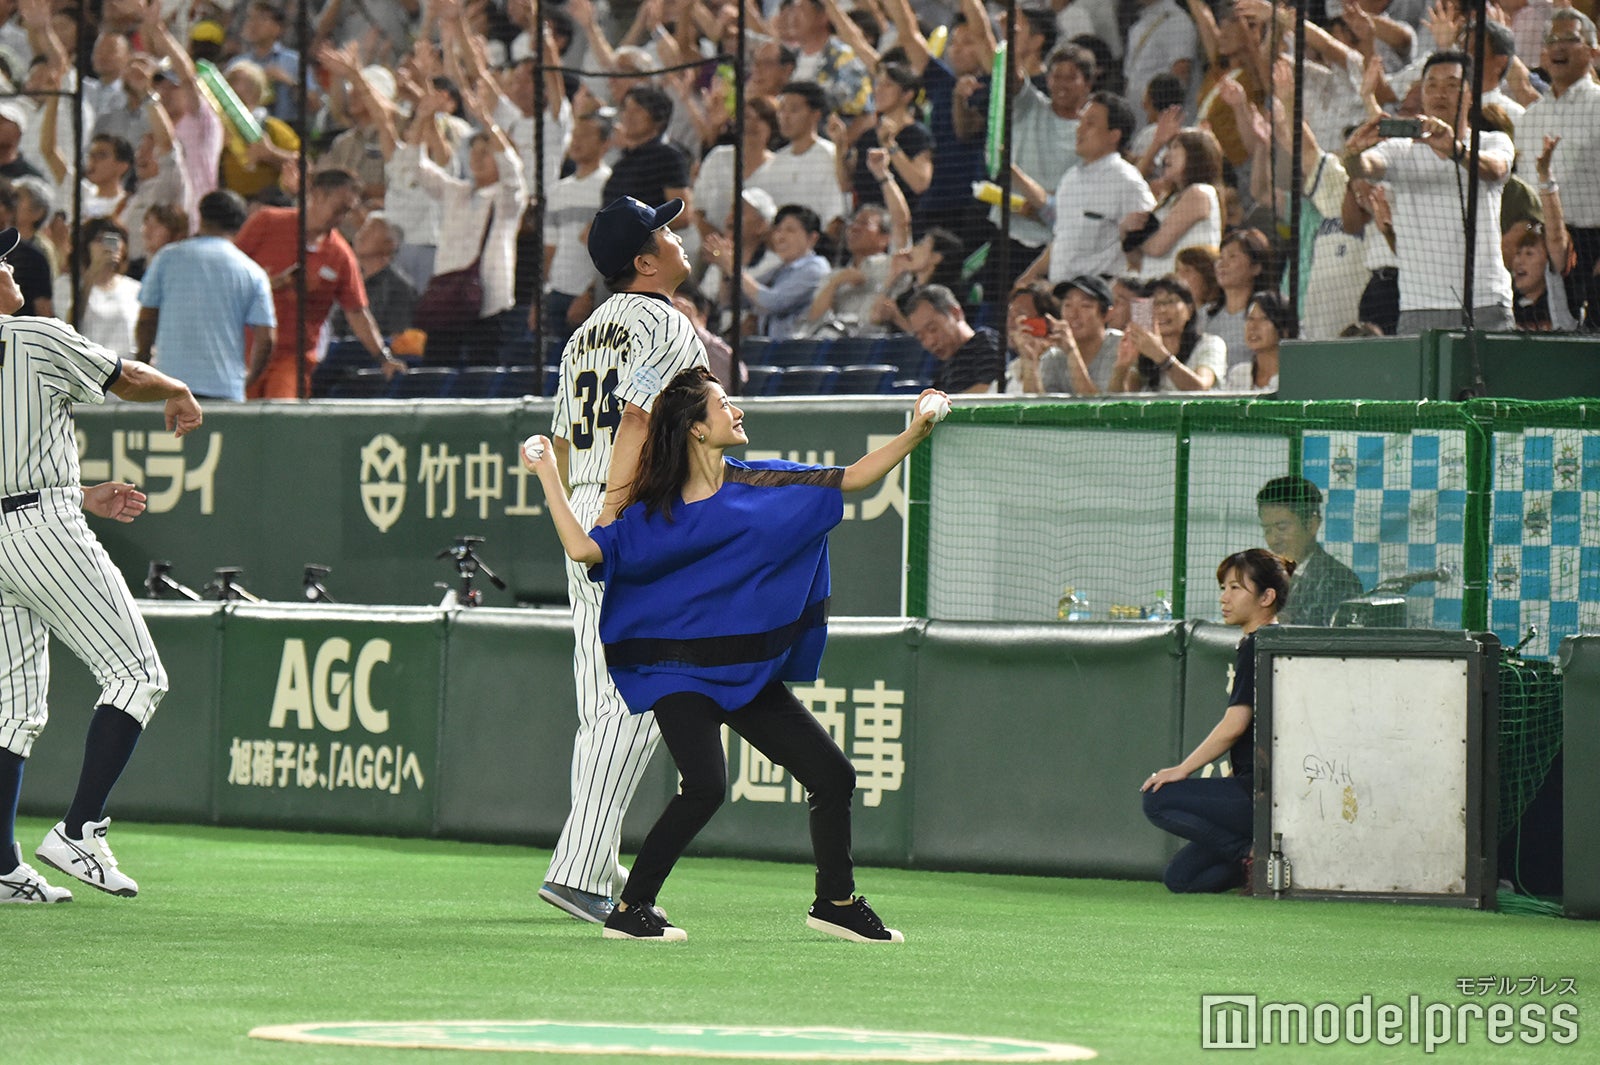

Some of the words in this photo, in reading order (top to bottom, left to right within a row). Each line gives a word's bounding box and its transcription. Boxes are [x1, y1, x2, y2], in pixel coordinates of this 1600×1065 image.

[572, 368, 627, 451] 34
[73, 430, 222, 515] ードライ
[417, 441, 550, 519] 竹中土
[269, 637, 392, 734] AGC
